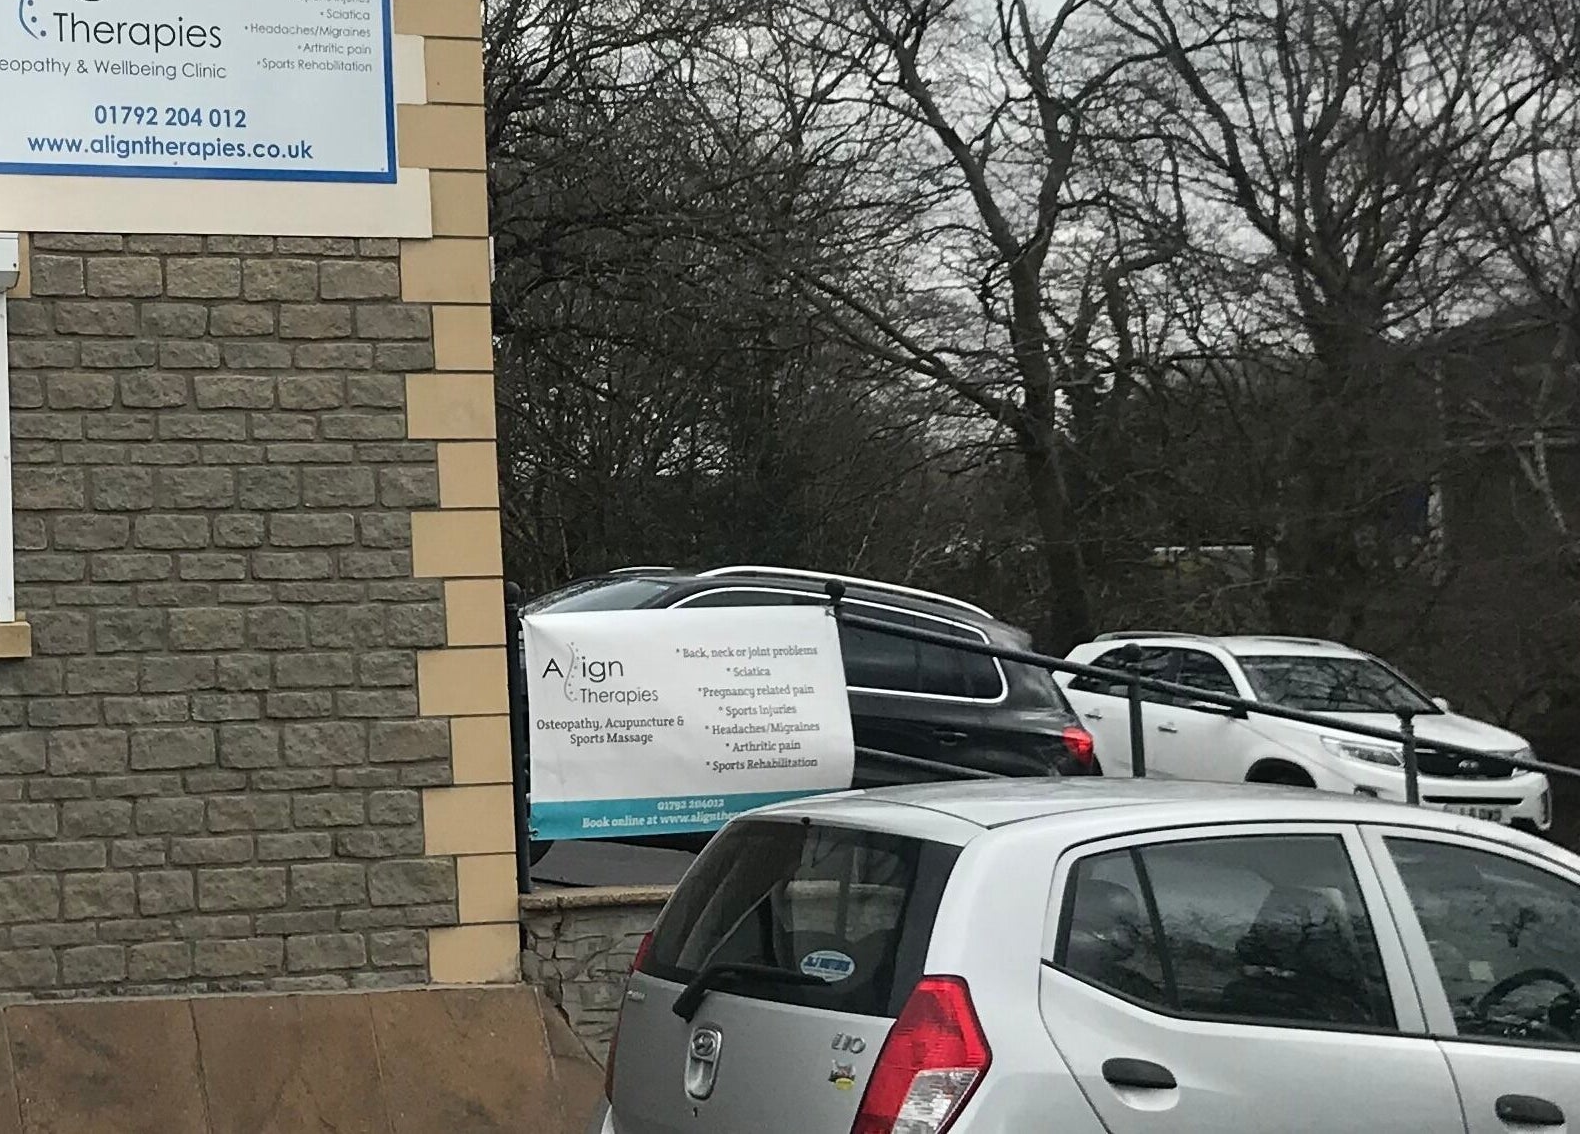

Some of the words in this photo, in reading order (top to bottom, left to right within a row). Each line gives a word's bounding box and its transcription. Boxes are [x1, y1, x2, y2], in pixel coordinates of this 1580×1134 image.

[326, 9, 371, 20] Sciatica
[53, 12, 222, 53] Therapies
[250, 23, 371, 39] Headaches/Migraines
[303, 43, 344, 54] Arthritic
[347, 44, 372, 56] pain
[76, 59, 89, 74] &
[94, 59, 177, 80] Wellbeing
[182, 62, 227, 79] Clinic
[262, 58, 295, 70] Sports
[298, 59, 372, 72] Rehabilitation
[94, 105, 158, 125] 01792
[165, 107, 202, 127] 204
[209, 109, 247, 128] 012
[27, 135, 313, 161] www.aligntherapies.co.uk
[683, 647, 709, 658] Back,
[711, 646, 734, 657] neck
[748, 646, 770, 659] joint
[773, 645, 818, 658] problems
[733, 666, 771, 677] Sciatica
[580, 686, 659, 705] Therapies
[702, 686, 755, 699] Pregnancy
[757, 684, 790, 696] related
[793, 685, 815, 697] pain
[725, 706, 757, 718] Sports
[759, 704, 797, 717] Injuries
[536, 718, 603, 732] Osteopathy,
[605, 717, 675, 730] Acupuncture
[677, 715, 684, 726] &
[712, 722, 820, 735] Headaches/Migraines
[570, 733, 604, 746] Sports
[606, 732, 653, 745] Massage
[732, 740, 776, 752] Arthritic
[778, 741, 801, 753] pain
[713, 760, 745, 773] Sports
[747, 757, 818, 769] Rehabilitation
[657, 800, 687, 811] 01792
[582, 816, 610, 828] Book
[611, 814, 645, 826] online
[646, 814, 658, 826] at
